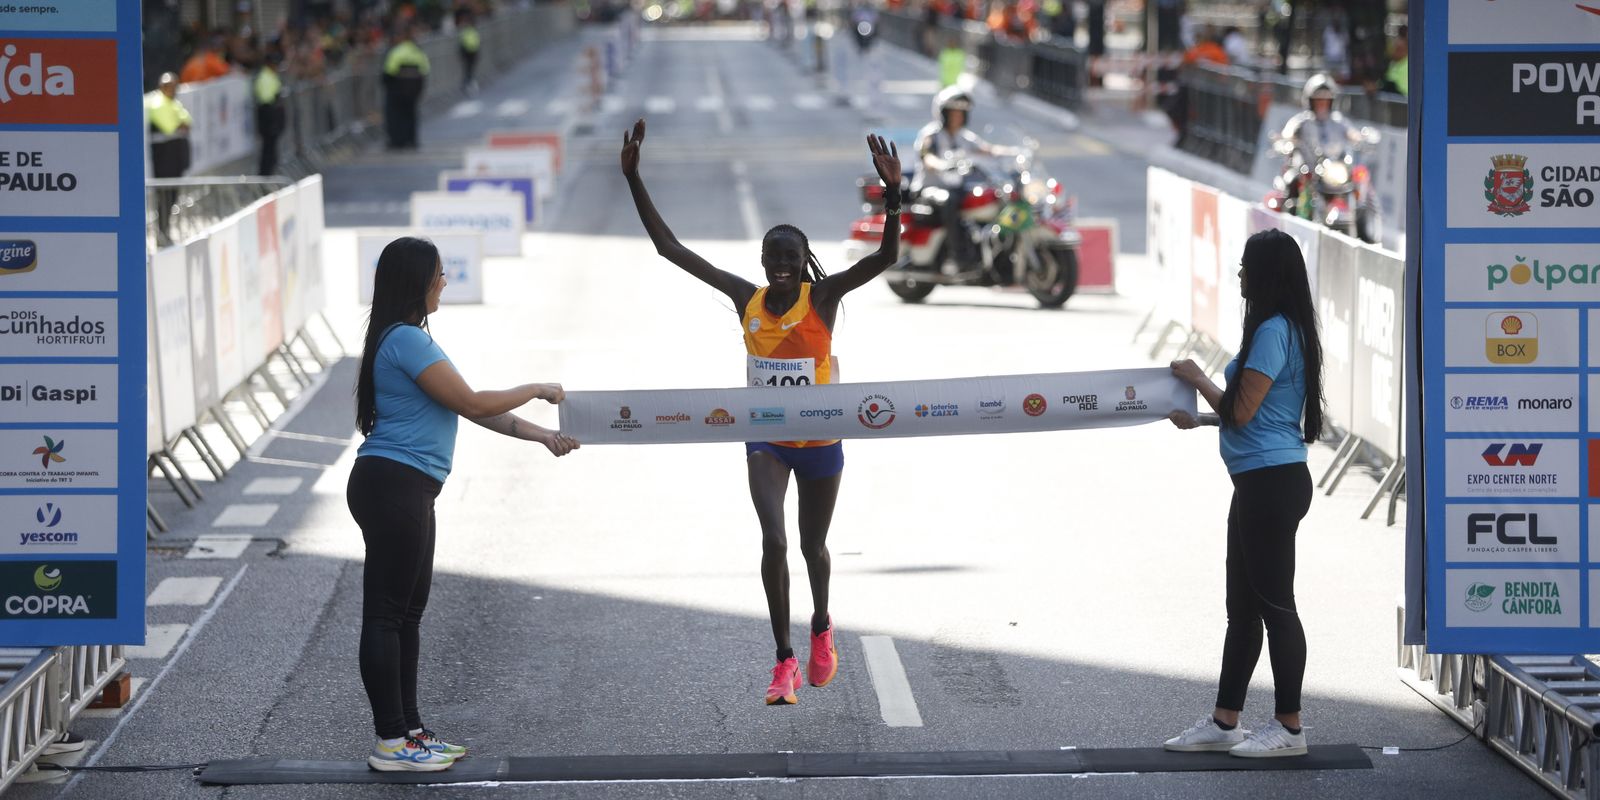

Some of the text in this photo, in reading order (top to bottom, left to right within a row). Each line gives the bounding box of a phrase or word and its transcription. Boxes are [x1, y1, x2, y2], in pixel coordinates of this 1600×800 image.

[19, 6, 59, 15] sempre.
[1512, 63, 1600, 93] POW
[1576, 95, 1600, 125] A
[17, 151, 43, 167] DE
[0, 172, 77, 191] PAULO
[1540, 184, 1595, 208] SÃO
[11, 311, 38, 320] DOIS
[37, 336, 105, 344] HORTIFRUTI
[1497, 344, 1526, 357] BOX
[1, 385, 96, 404] Di Gaspi
[1062, 394, 1098, 404] POWER
[1466, 396, 1509, 406] REMA
[930, 403, 959, 411] loterias
[1079, 402, 1098, 411] ADE
[1518, 398, 1572, 410] monaro
[656, 411, 691, 422] movida
[931, 409, 959, 417] CAIXA
[1467, 474, 1558, 485] EXPO CENTER NORTE
[1467, 513, 1558, 545] FCL
[20, 532, 78, 545] yescom
[1504, 582, 1560, 597] BENDITA
[5, 595, 90, 615] COPRA
[1501, 597, 1562, 615] CÂNFORA
